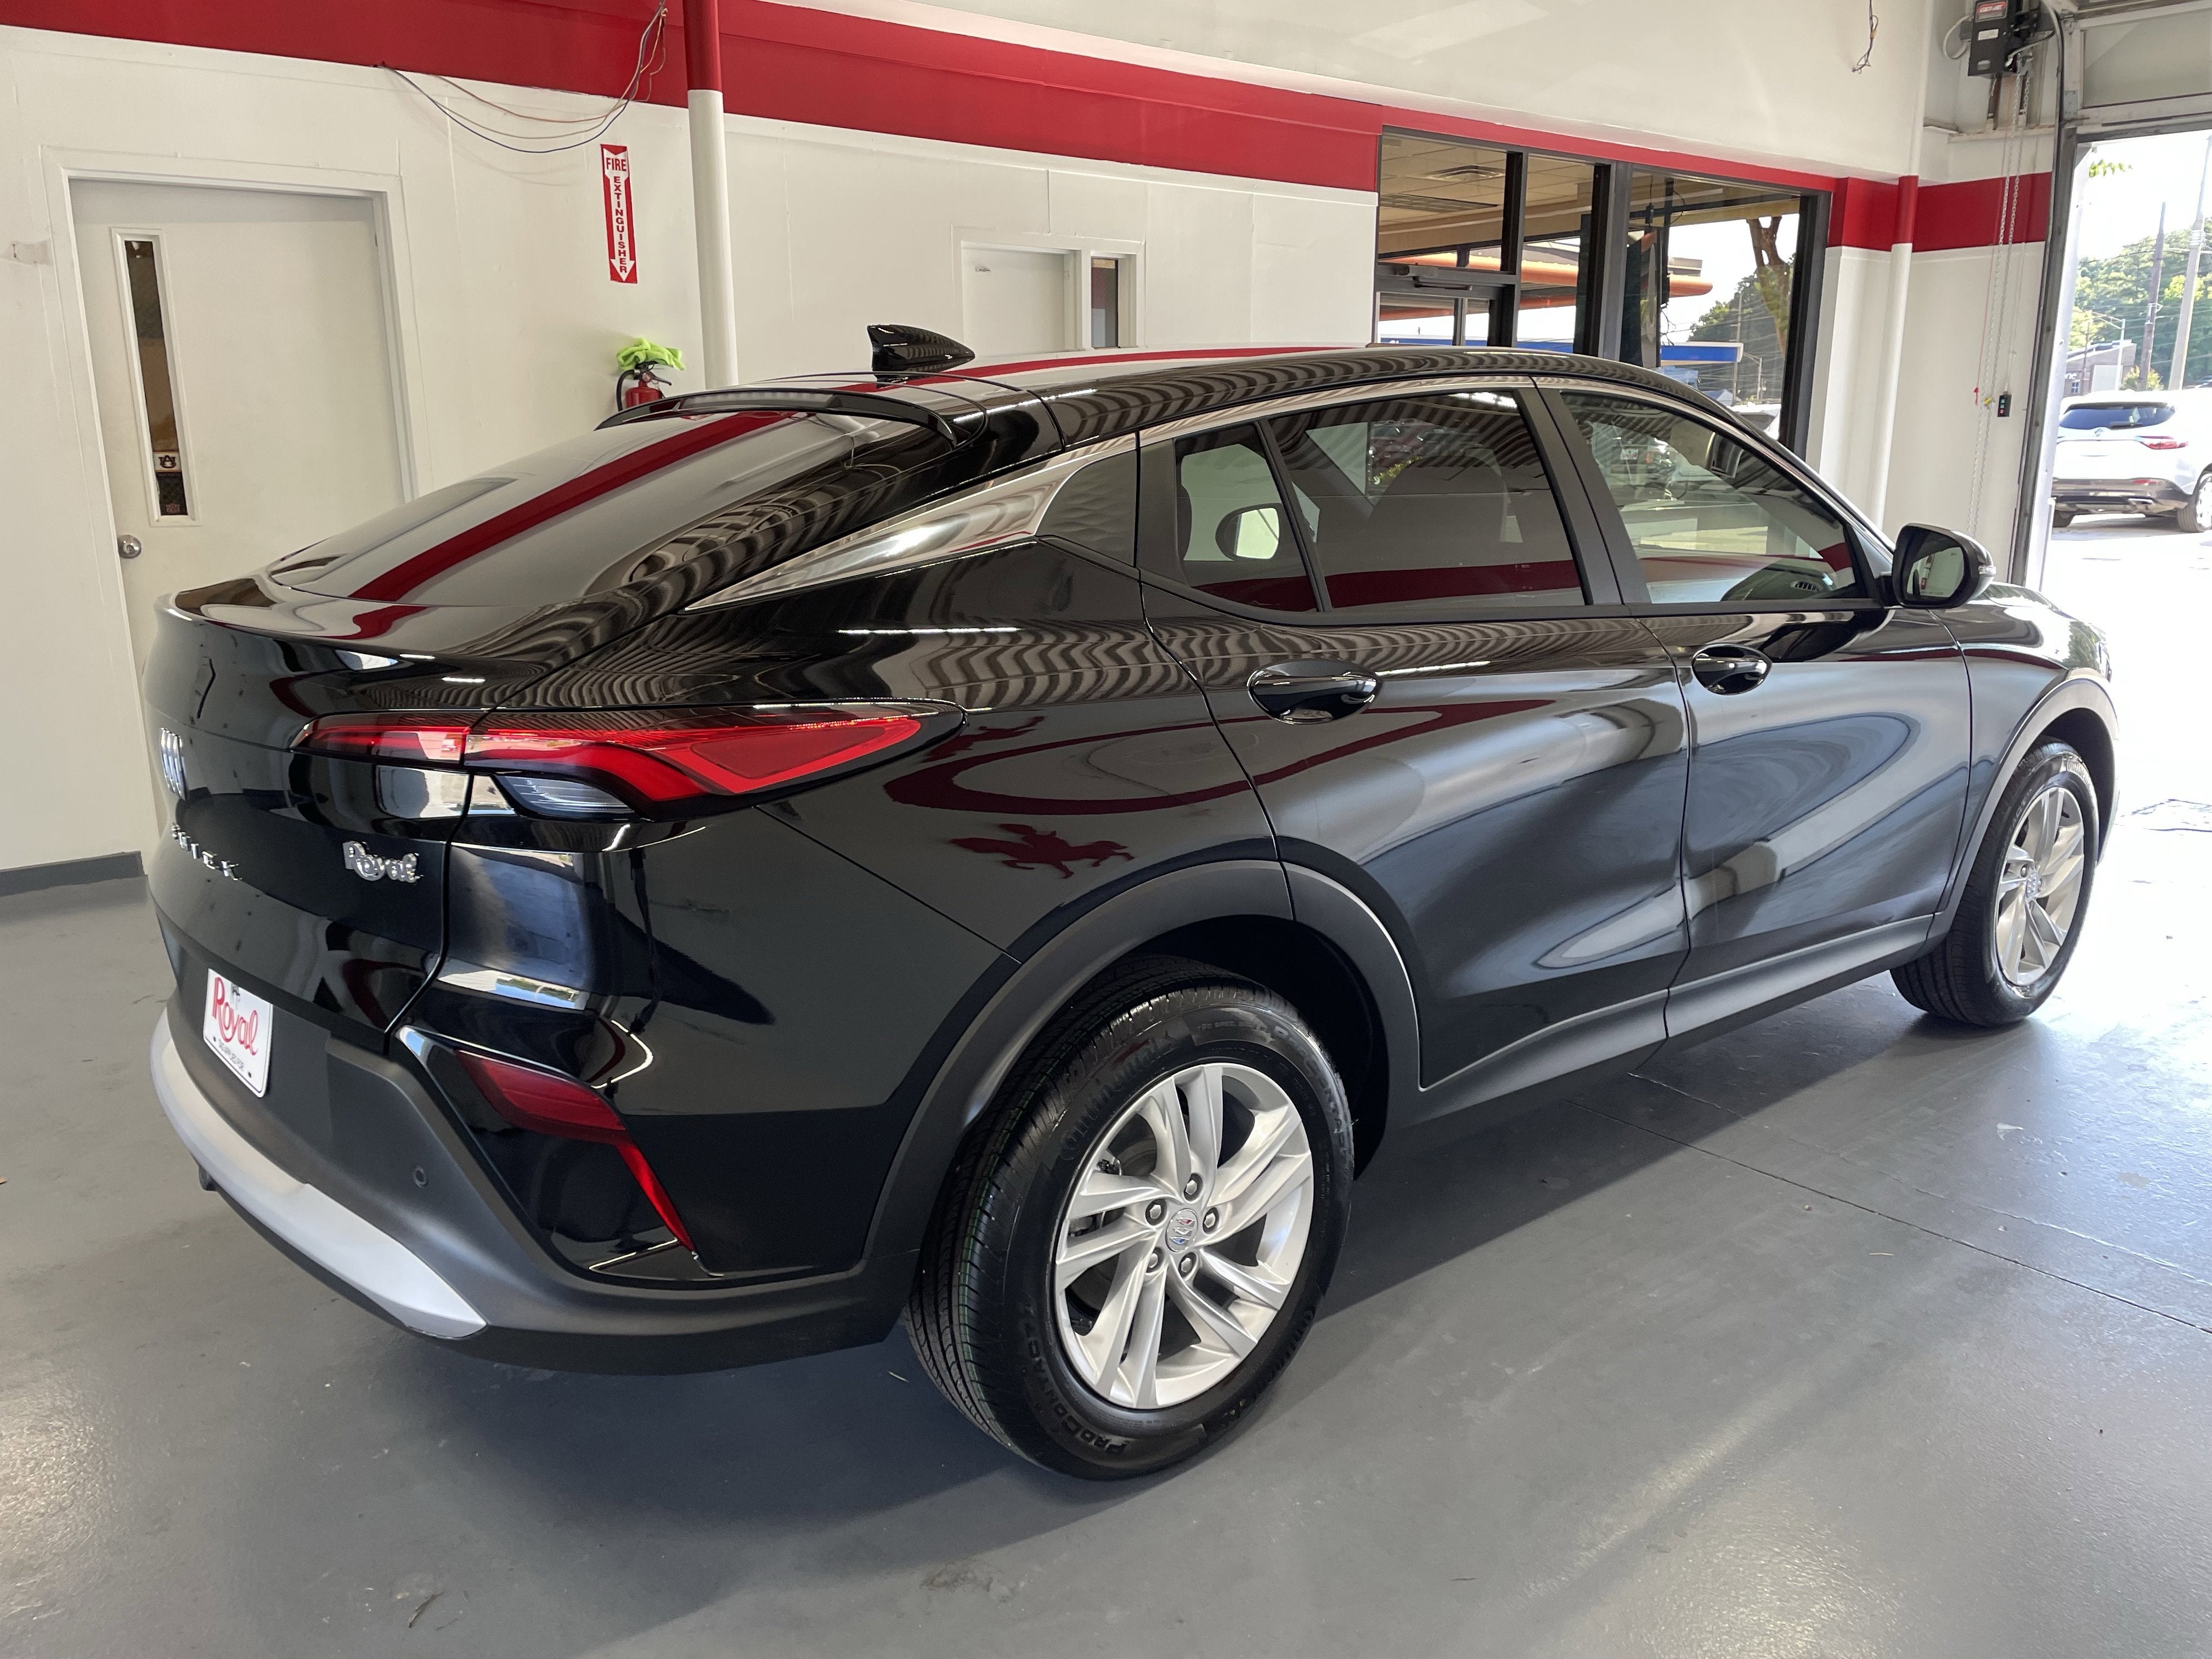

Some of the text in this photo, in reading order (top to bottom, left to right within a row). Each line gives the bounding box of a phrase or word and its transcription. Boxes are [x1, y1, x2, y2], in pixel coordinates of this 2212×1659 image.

[606, 157, 627, 172] FIRE
[613, 176, 627, 273] EXTINGUISHER
[342, 840, 421, 883] Royal
[212, 977, 258, 1056] Royal
